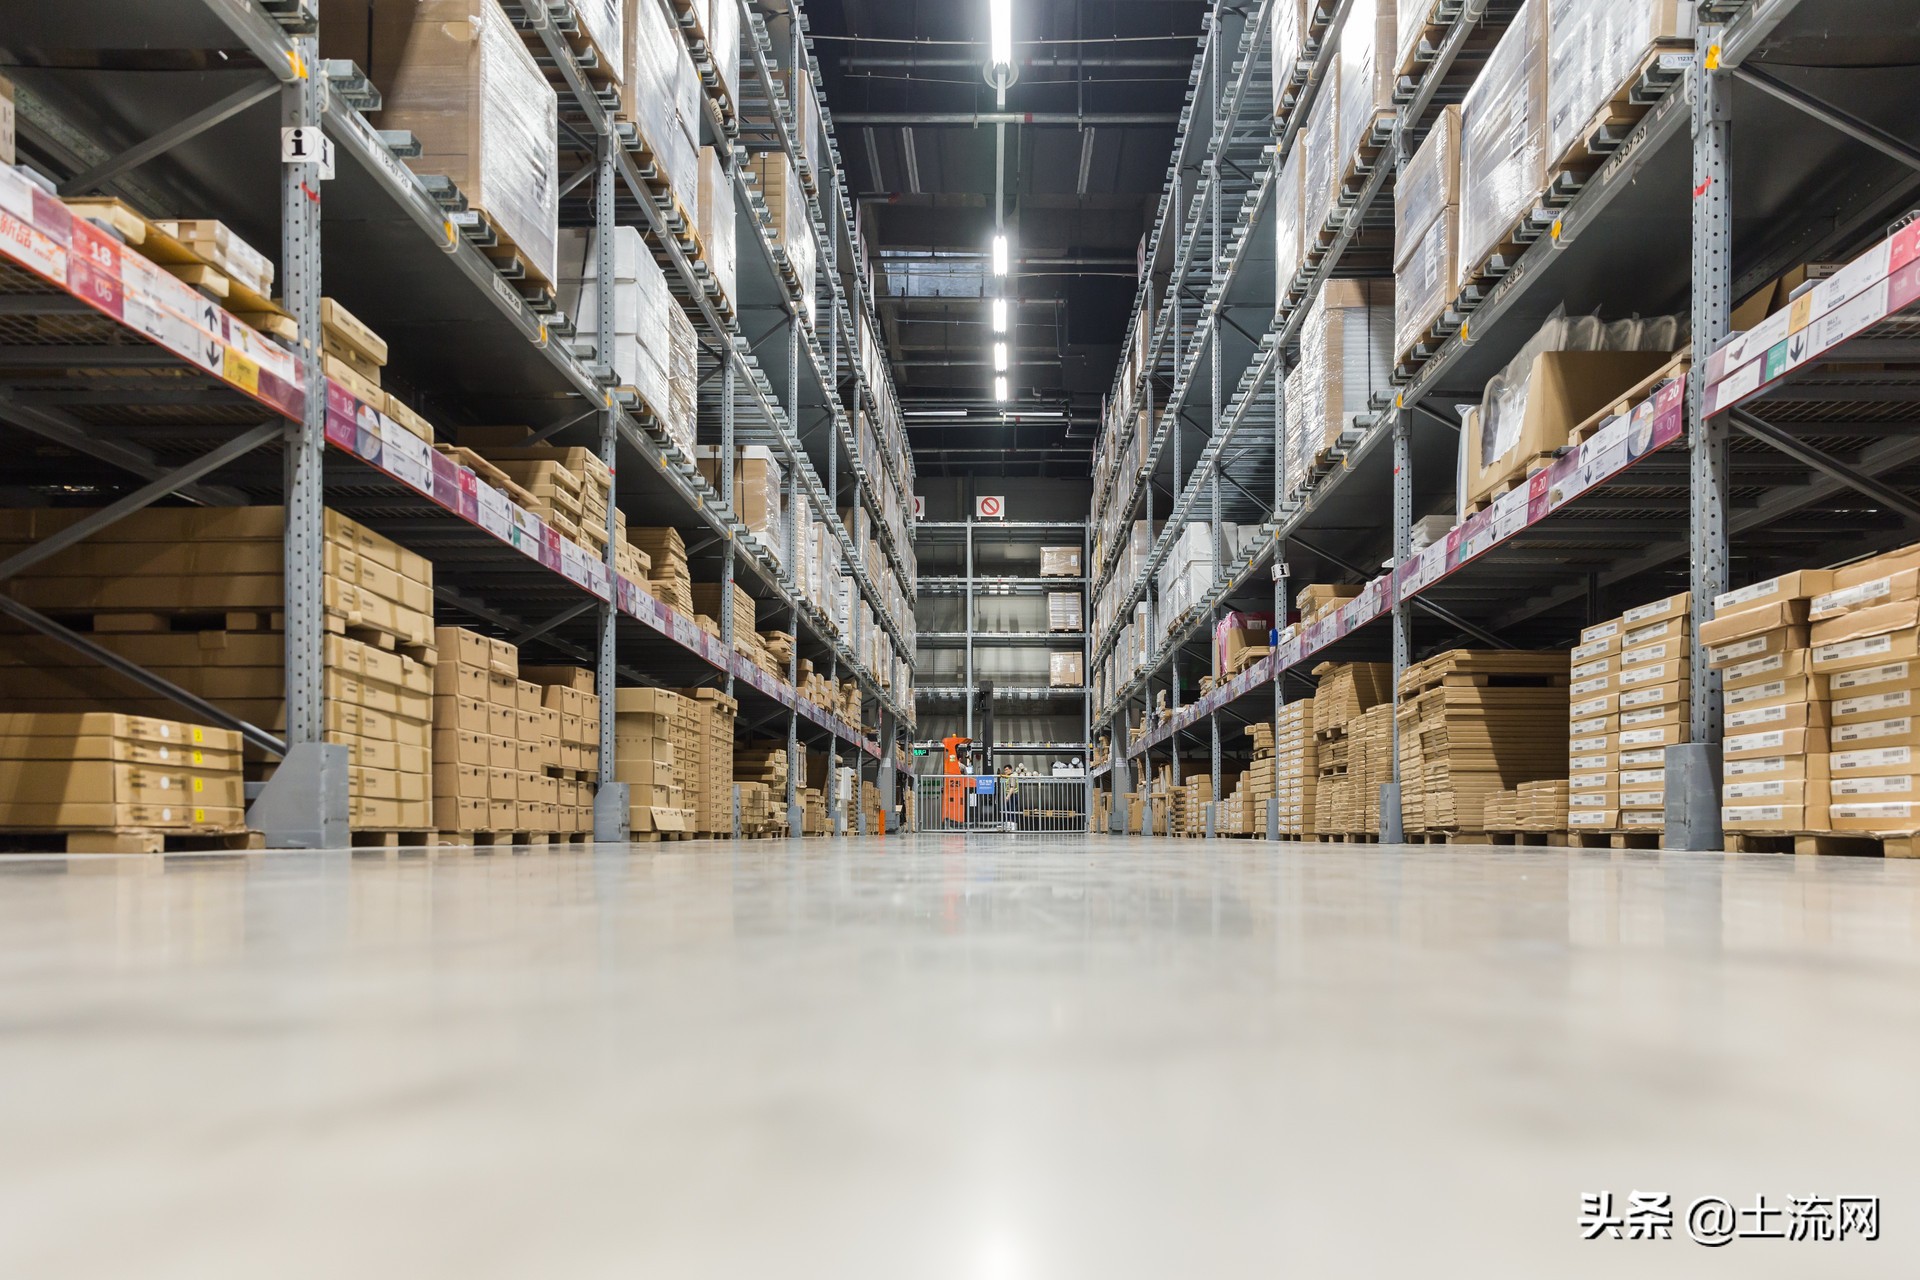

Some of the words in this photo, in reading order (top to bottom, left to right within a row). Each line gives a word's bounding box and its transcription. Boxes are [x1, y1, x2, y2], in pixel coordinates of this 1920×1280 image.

[291, 129, 306, 155] i
[322, 138, 329, 167] i
[1, 212, 32, 248] 新品
[91, 242, 112, 267] 18
[95, 278, 113, 302] 06
[1667, 384, 1680, 401] 20
[343, 397, 354, 416] 18
[1666, 414, 1676, 430] 07
[340, 426, 351, 438] 07
[467, 478, 477, 493] 18
[1279, 564, 1287, 576] i
